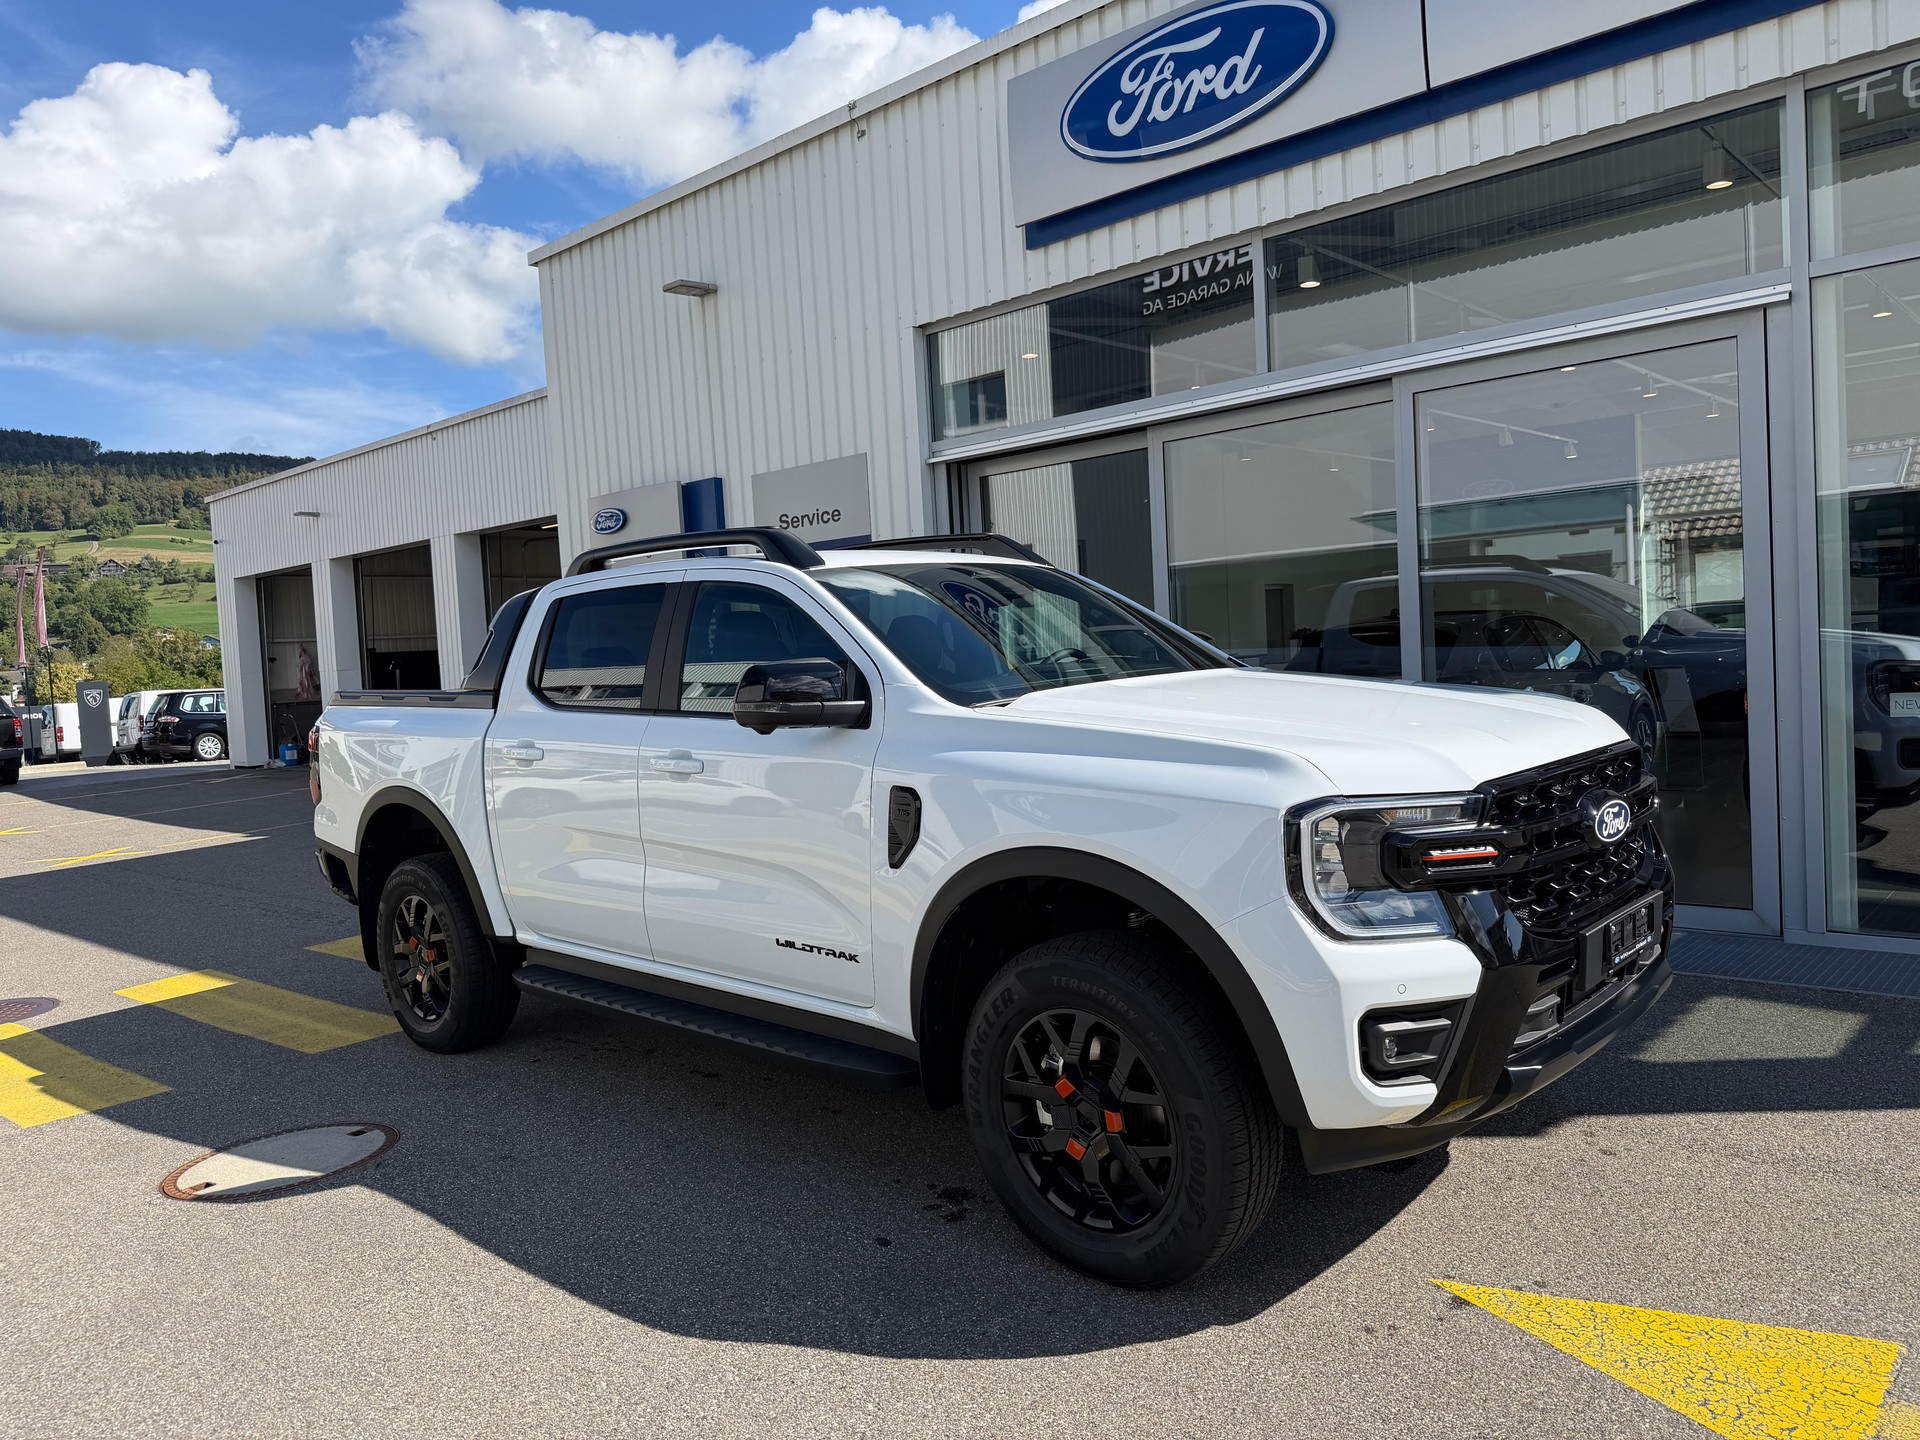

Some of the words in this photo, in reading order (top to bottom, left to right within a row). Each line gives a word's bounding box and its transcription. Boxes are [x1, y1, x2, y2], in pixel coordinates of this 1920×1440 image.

[1107, 26, 1266, 138] Ford
[596, 512, 617, 530] Ford
[779, 508, 842, 530] Service
[1603, 806, 1626, 837] Ford
[775, 938, 861, 964] WILDTRAK
[1051, 975, 1139, 1021] TERRITORY
[1146, 1031, 1167, 1056] HT
[968, 986, 1016, 1130] WRANGLER
